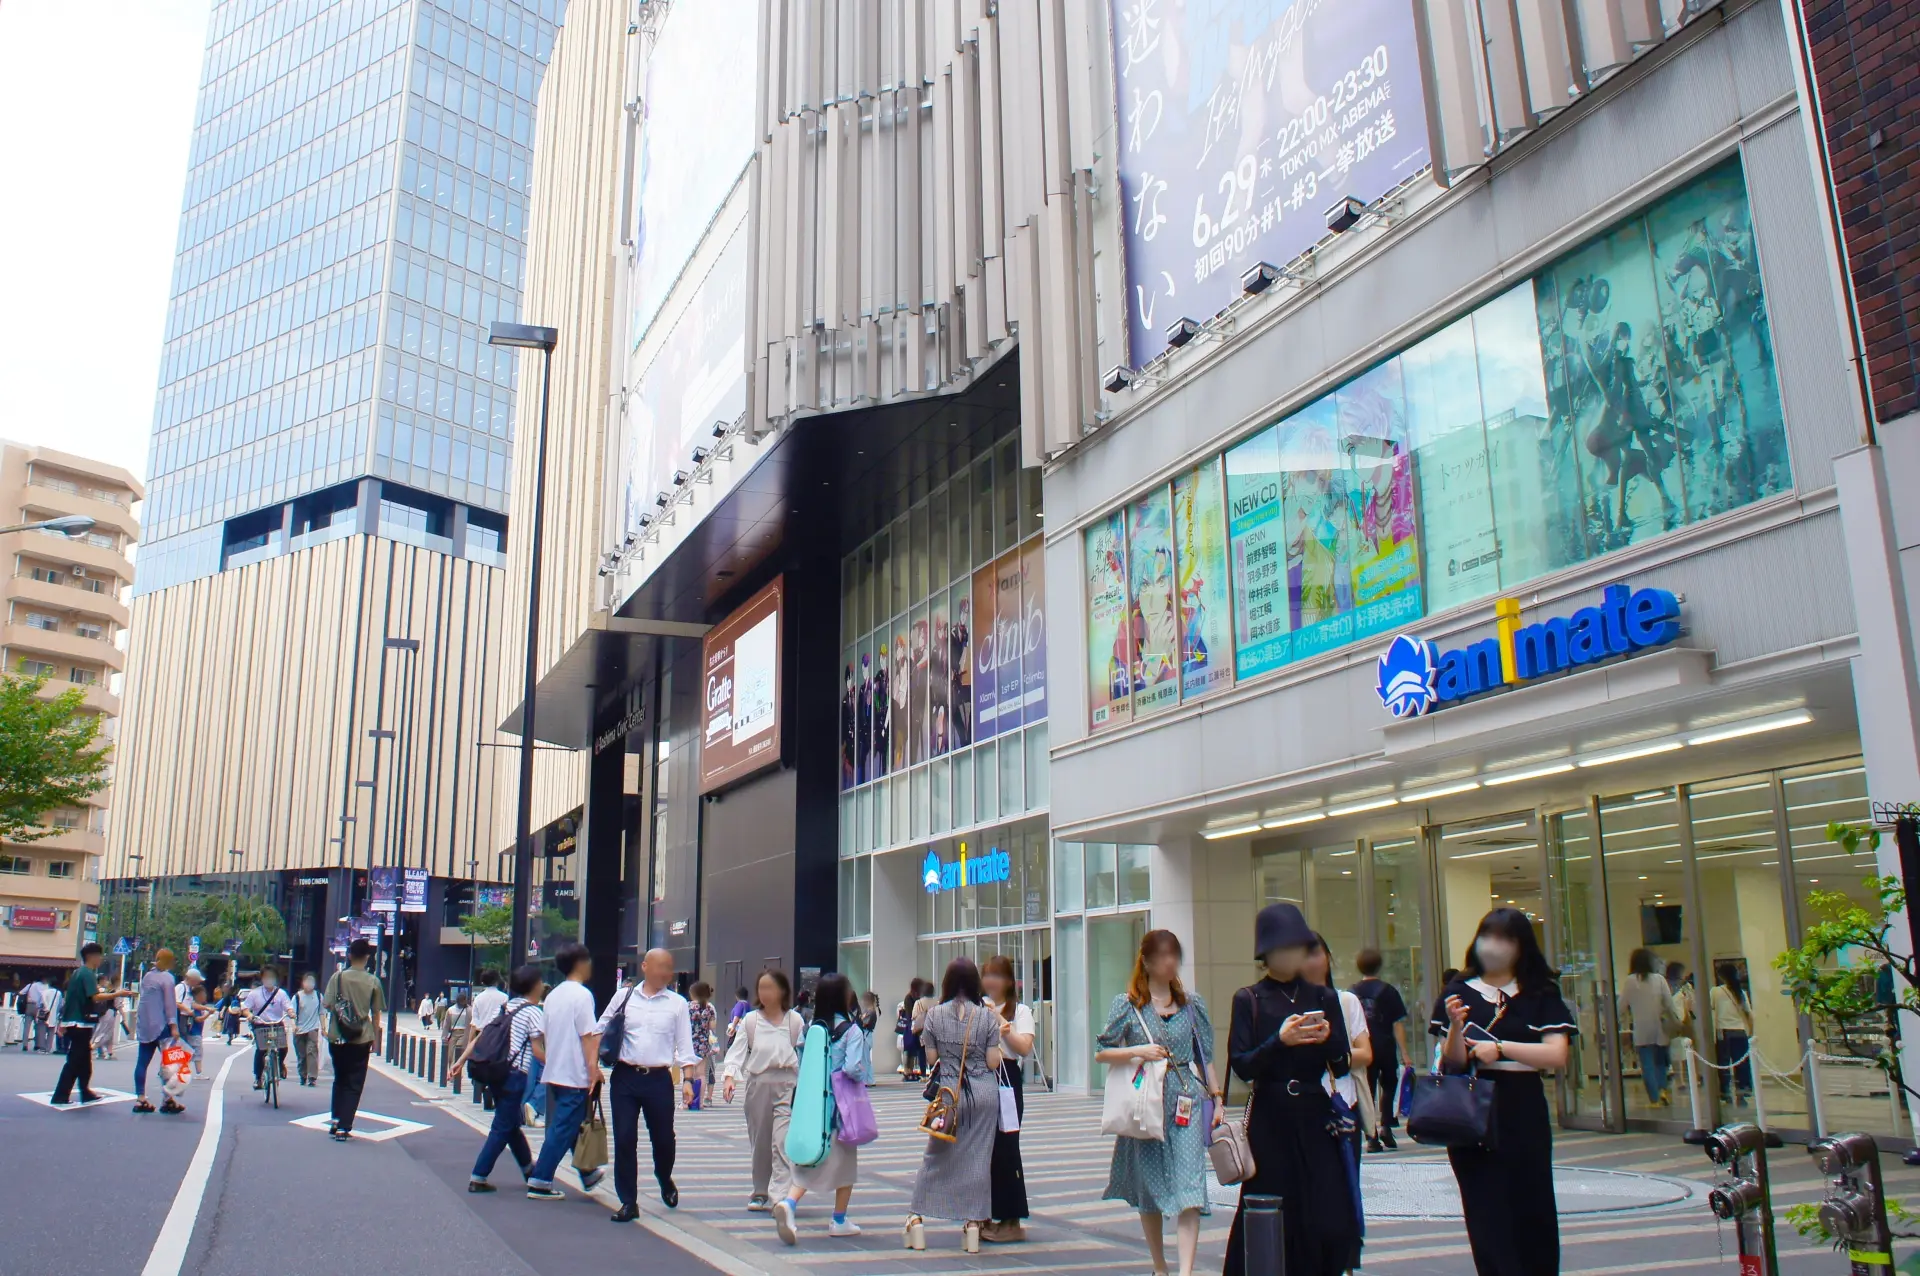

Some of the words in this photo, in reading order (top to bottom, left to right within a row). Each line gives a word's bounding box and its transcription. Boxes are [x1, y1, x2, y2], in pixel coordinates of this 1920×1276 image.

[1276, 45, 1388, 159] 22:00-23:30
[1259, 157, 1273, 179] 木
[1280, 140, 1318, 180] TOKYO
[1192, 154, 1258, 248] 6.29
[1233, 490, 1259, 518] NEW
[1261, 482, 1278, 505] CD
[1245, 528, 1266, 548] KENN
[1246, 541, 1277, 567] 前野智昭
[1438, 584, 1681, 701] animate
[707, 675, 732, 712] Gratte
[1001, 681, 1010, 695] 1st
[1010, 679, 1019, 692] EP
[599, 729, 616, 751] Toshima
[617, 720, 628, 738] Civic
[629, 706, 646, 729] Center
[404, 868, 428, 878] BLEACH
[941, 841, 1010, 891] animate
